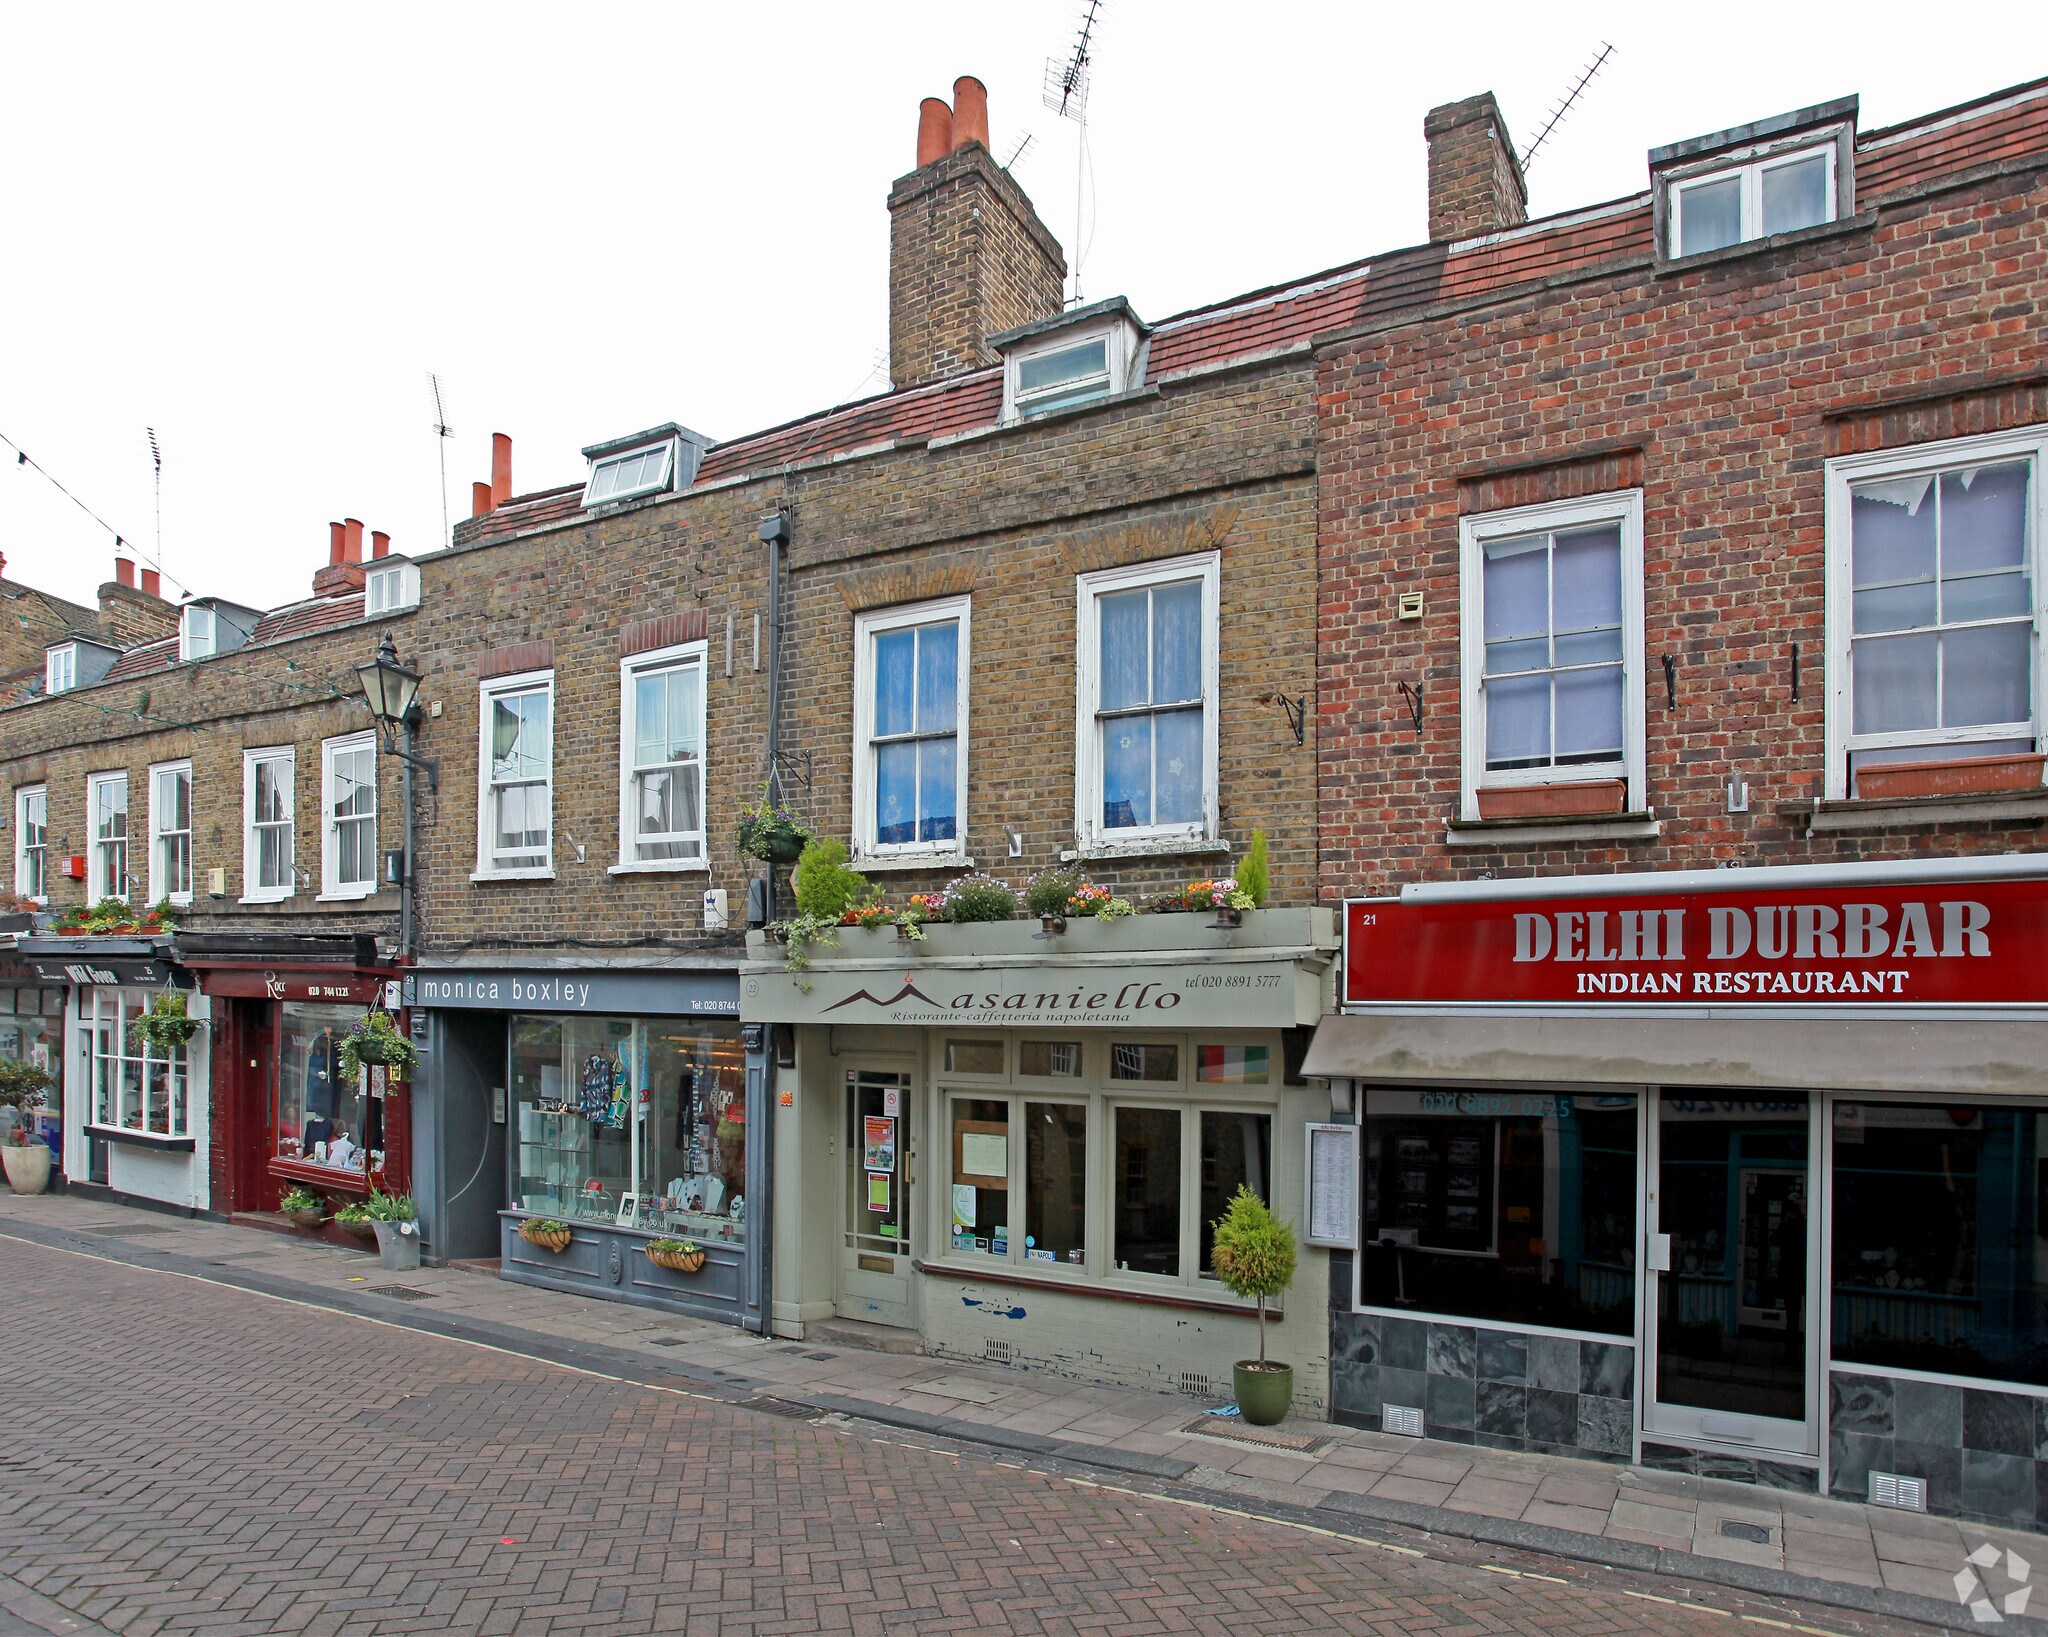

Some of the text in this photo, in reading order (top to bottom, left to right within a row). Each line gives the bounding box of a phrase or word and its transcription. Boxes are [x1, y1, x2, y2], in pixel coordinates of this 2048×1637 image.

[1363, 914, 1376, 925] 21
[1512, 900, 1992, 963] DELHI DURBAR
[1185, 974, 1282, 988] tel 020 8891 5777
[1576, 970, 1910, 994] INDIAN RESTAURANT
[308, 986, 320, 996] 020
[424, 978, 589, 1006] monica boxley
[748, 984, 757, 993] 22
[690, 1000, 703, 1010] Tel:
[703, 1000, 718, 1010] 020
[718, 1001, 736, 1011] 8744
[890, 1010, 1130, 1024] Ristorante-caffetteria napoletana
[1423, 1095, 1457, 1114] 020
[1466, 1096, 1512, 1115] 8892
[1522, 1098, 1570, 1118] 0225
[1037, 1251, 1052, 1260] NAPOLI
